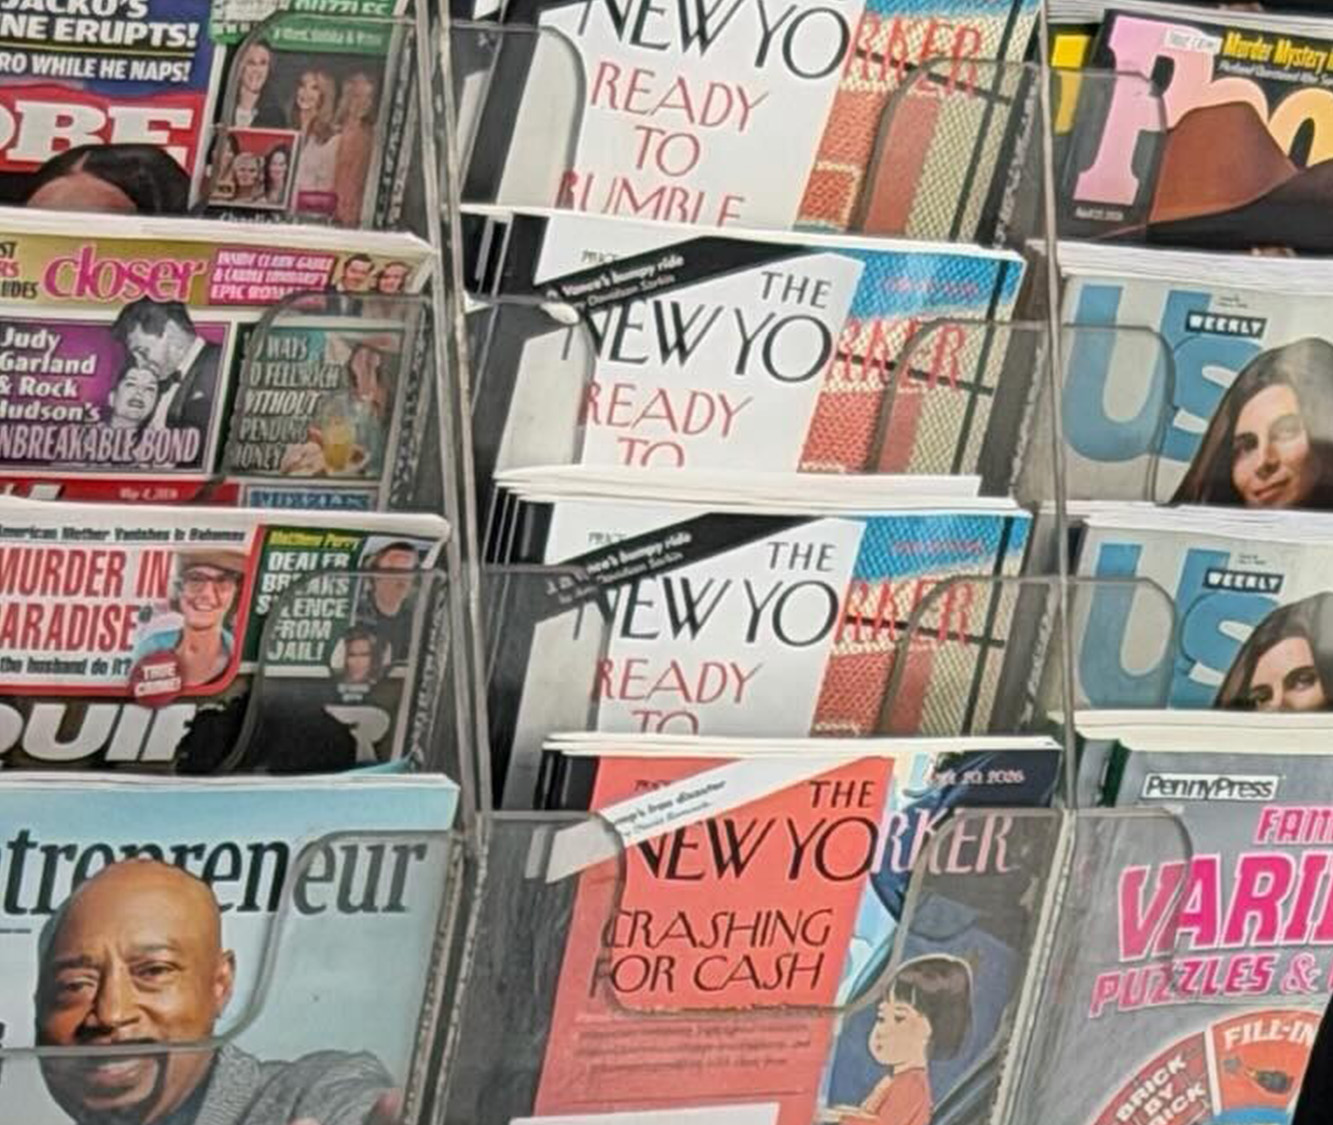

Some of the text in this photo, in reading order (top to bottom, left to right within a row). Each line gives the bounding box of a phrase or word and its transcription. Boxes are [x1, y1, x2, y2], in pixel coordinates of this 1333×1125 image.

[53, 19, 200, 48] ERUPTS!
[1223, 31, 1272, 61] Murder
[1273, 38, 1326, 75] Mystery
[31, 55, 97, 78] WHILE
[100, 60, 128, 80] HE
[129, 61, 192, 82] NAPS!
[591, 60, 768, 133] READY
[635, 125, 700, 178] TO
[44, 246, 205, 301] closer
[761, 271, 832, 309] THE
[1, 327, 60, 350] Judy
[1189, 314, 1263, 336] WEEKLY
[0, 351, 97, 374] Garland
[0, 375, 78, 397] & Rock
[577, 381, 753, 438] READY
[136, 428, 199, 462] BOND
[616, 437, 686, 467] TO
[0, 547, 174, 599] MURDER IN
[767, 541, 837, 574] THE
[1207, 571, 1281, 591] WEEKLY
[0, 602, 142, 652] ARADISE
[593, 656, 766, 705] READY
[808, 780, 876, 809] THE
[631, 807, 1022, 884] NEW YORKER
[603, 908, 834, 952] CRASHING
[588, 952, 827, 999] FOR CASH
[1088, 954, 1320, 1018] PUZZLES &
[1115, 1053, 1187, 1124] BRICK
[1143, 1082, 1176, 1118] BY
